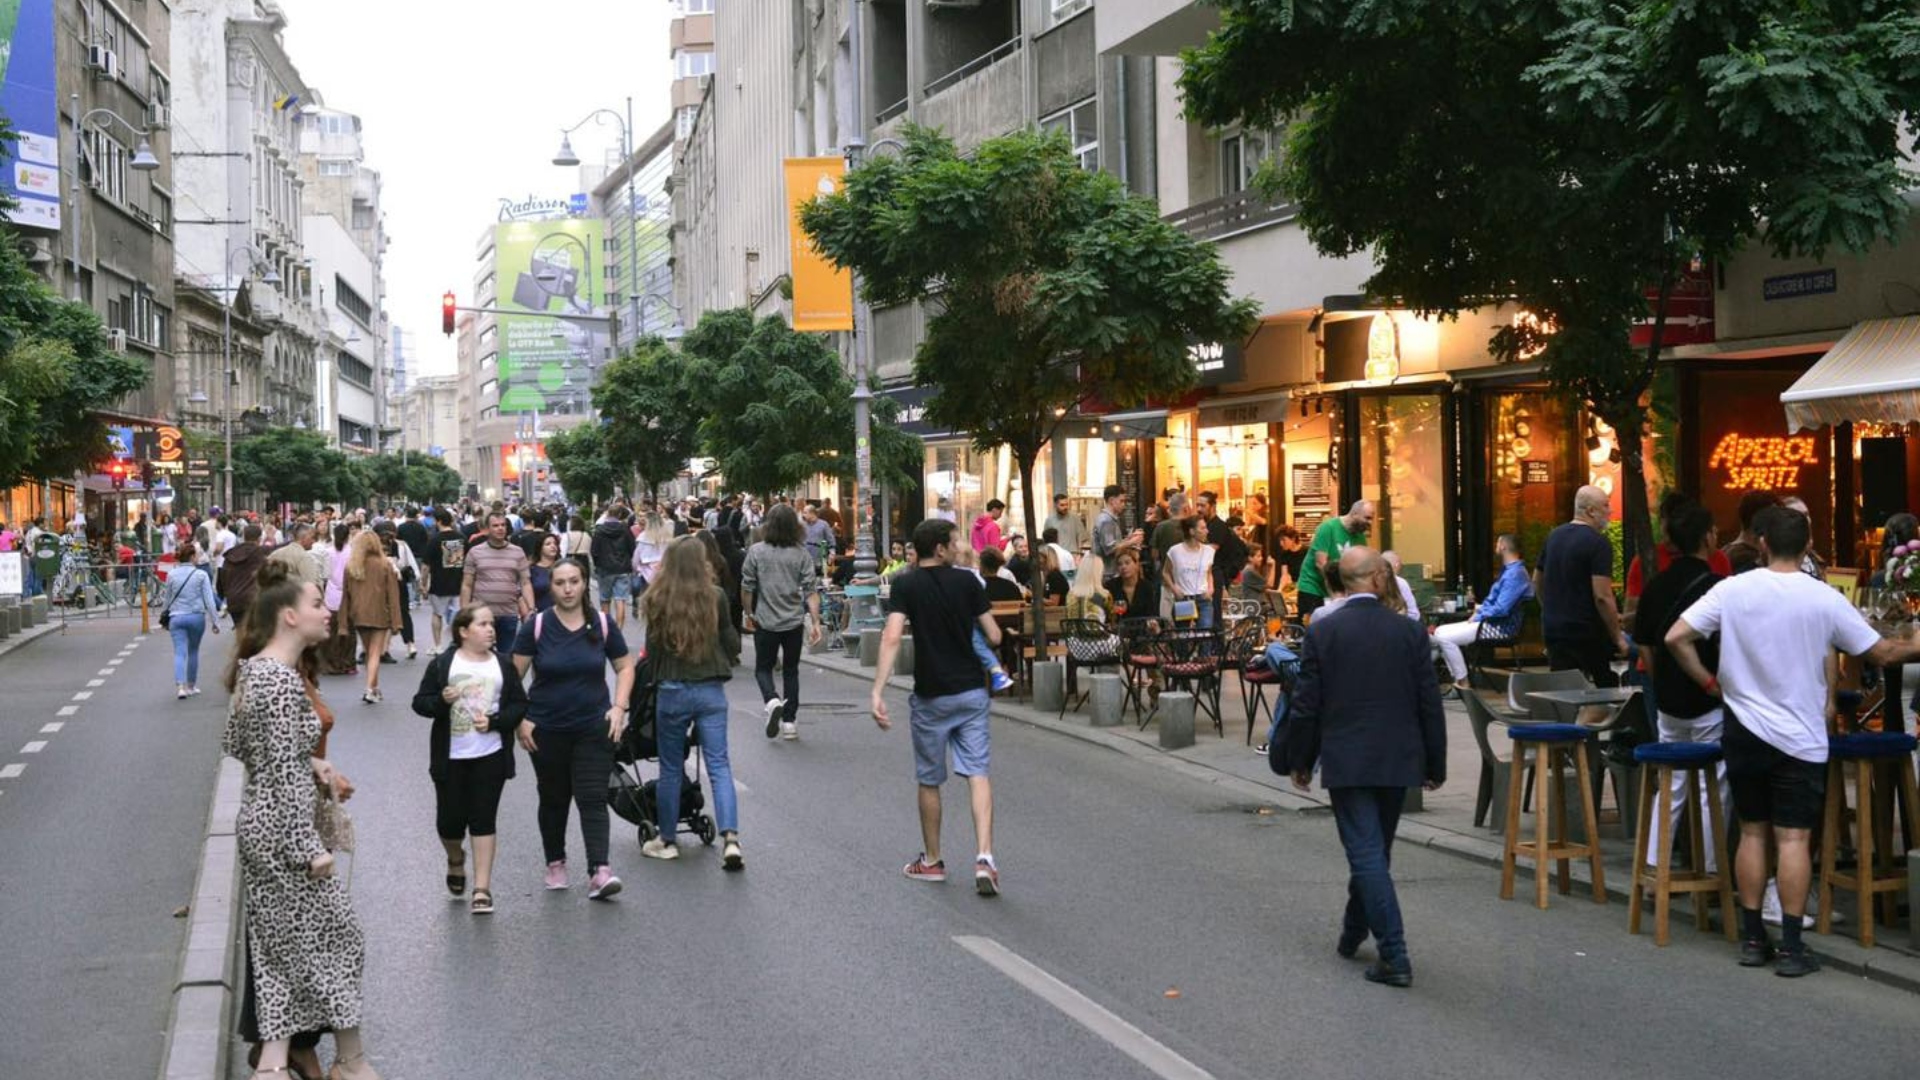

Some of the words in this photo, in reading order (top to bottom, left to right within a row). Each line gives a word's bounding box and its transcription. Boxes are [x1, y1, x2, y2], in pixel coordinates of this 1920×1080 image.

[498, 194, 570, 221] Radisson
[1708, 432, 1818, 467] APEROL
[1724, 466, 1799, 490] SPRITZ
